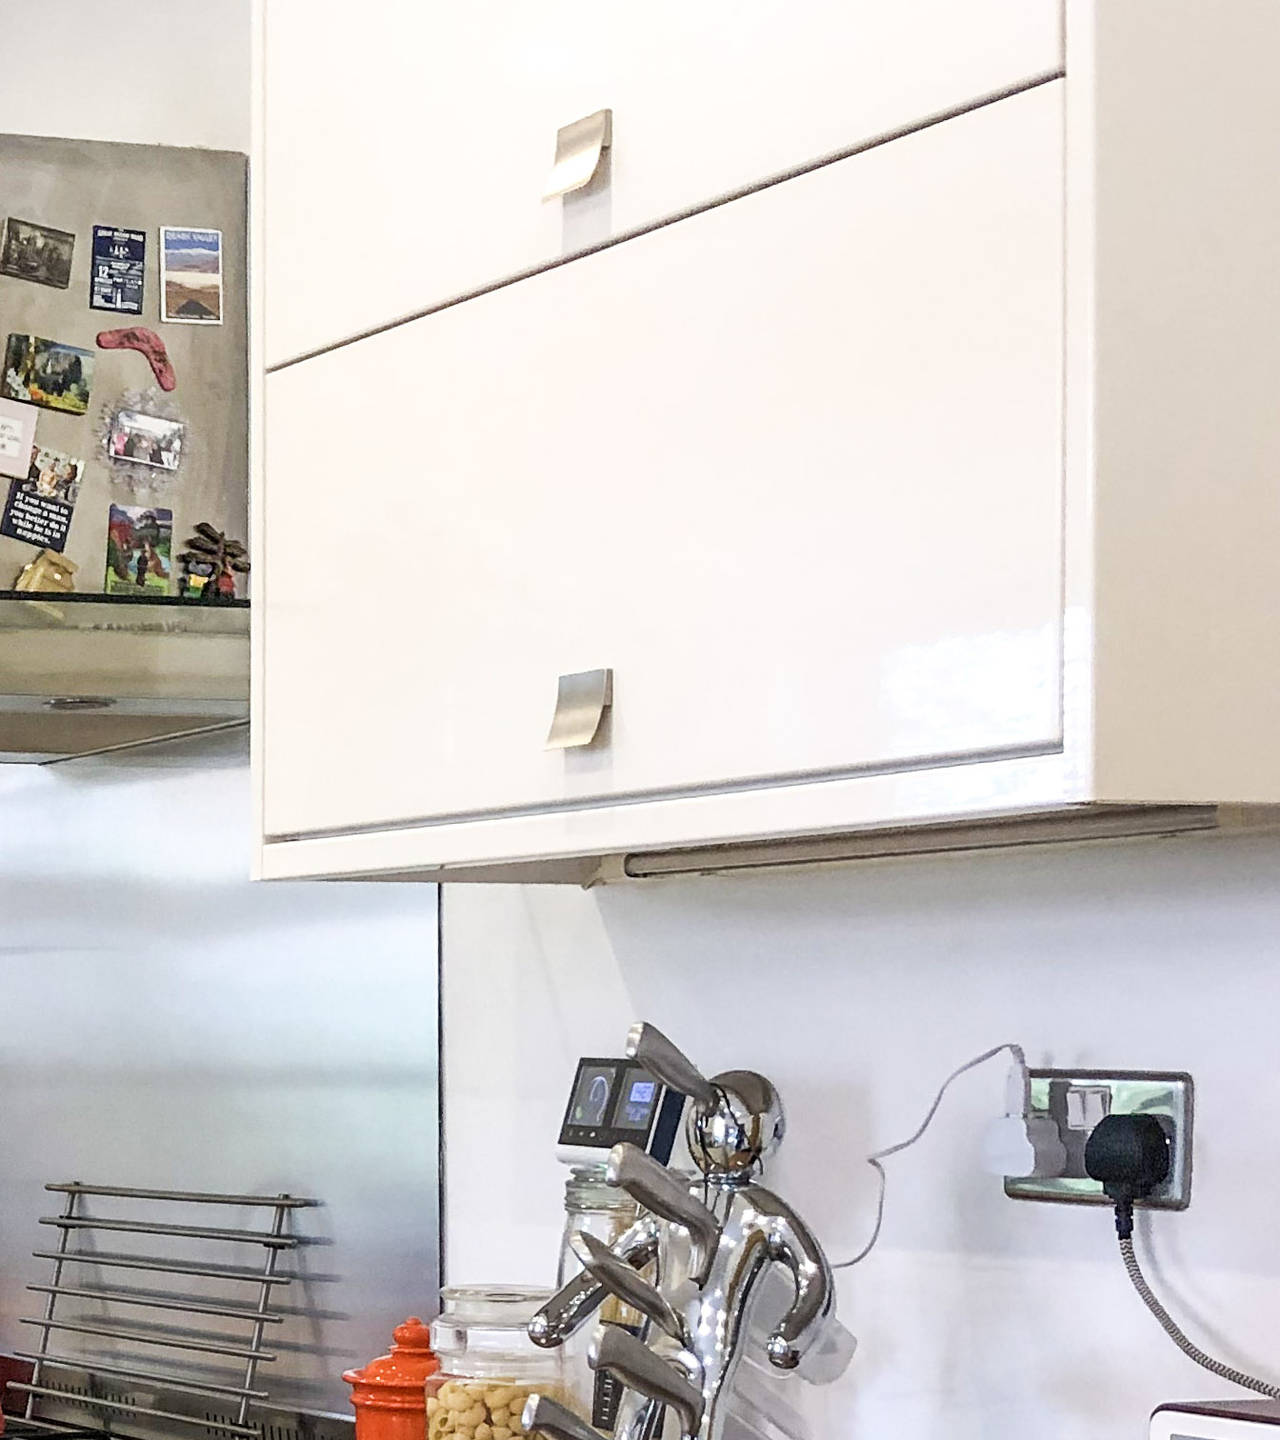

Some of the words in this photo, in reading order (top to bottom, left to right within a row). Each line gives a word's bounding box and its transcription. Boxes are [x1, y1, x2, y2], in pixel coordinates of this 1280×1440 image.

[14, 501, 42, 514] change
[16, 492, 24, 500] If
[25, 496, 39, 505] you
[40, 501, 59, 512] want
[9, 509, 24, 518] you
[25, 513, 49, 526] better
[49, 521, 59, 530] do
[12, 518, 33, 529] while
[34, 524, 43, 533] he
[44, 528, 51, 536] is
[52, 531, 60, 539] in
